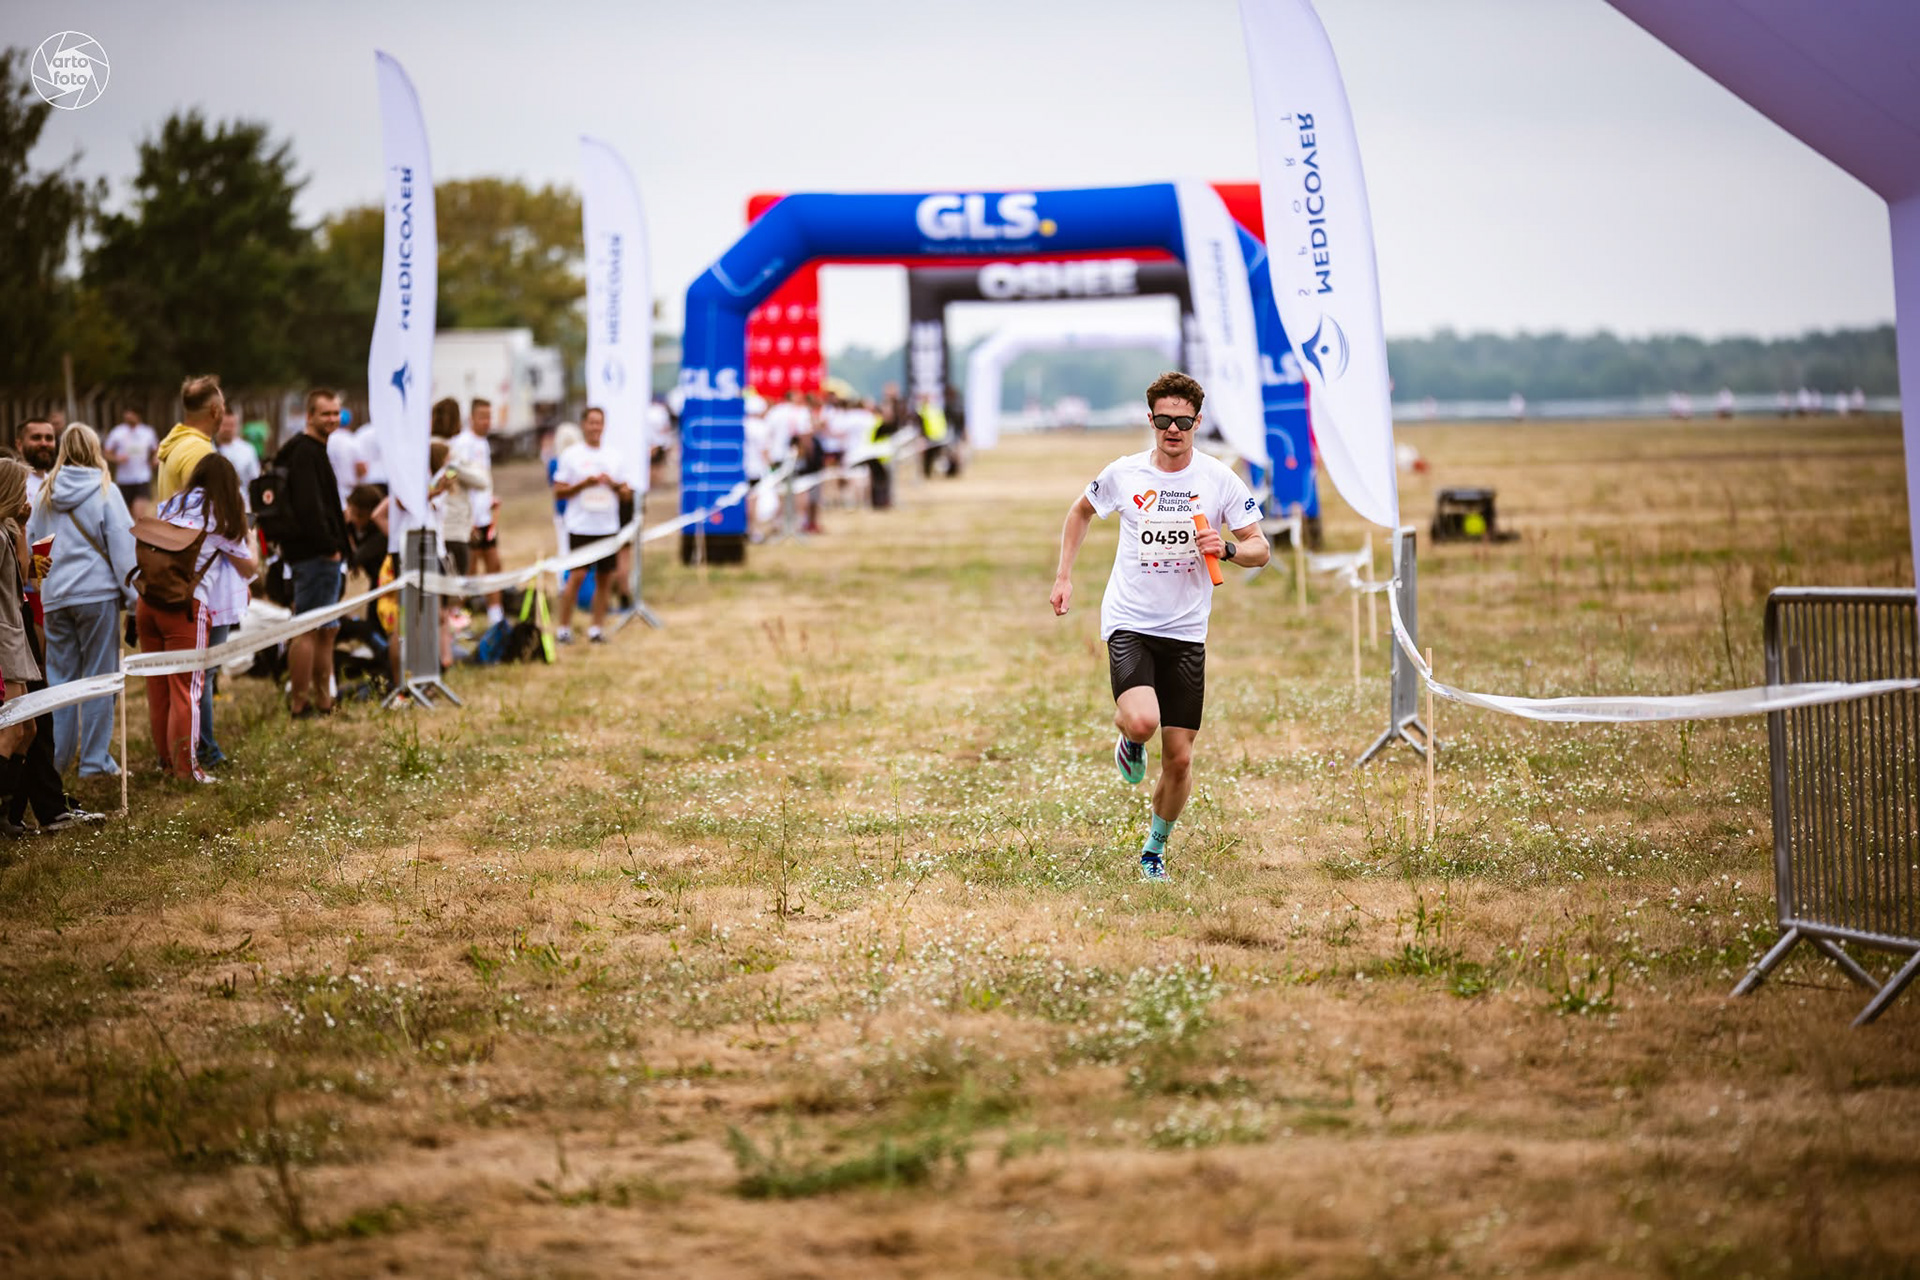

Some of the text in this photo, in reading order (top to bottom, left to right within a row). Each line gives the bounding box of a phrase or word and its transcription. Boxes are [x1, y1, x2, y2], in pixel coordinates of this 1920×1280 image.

[1259, 351, 1304, 386] LS
[1160, 490, 1191, 498] Poland
[1141, 530, 1189, 545] 0459
